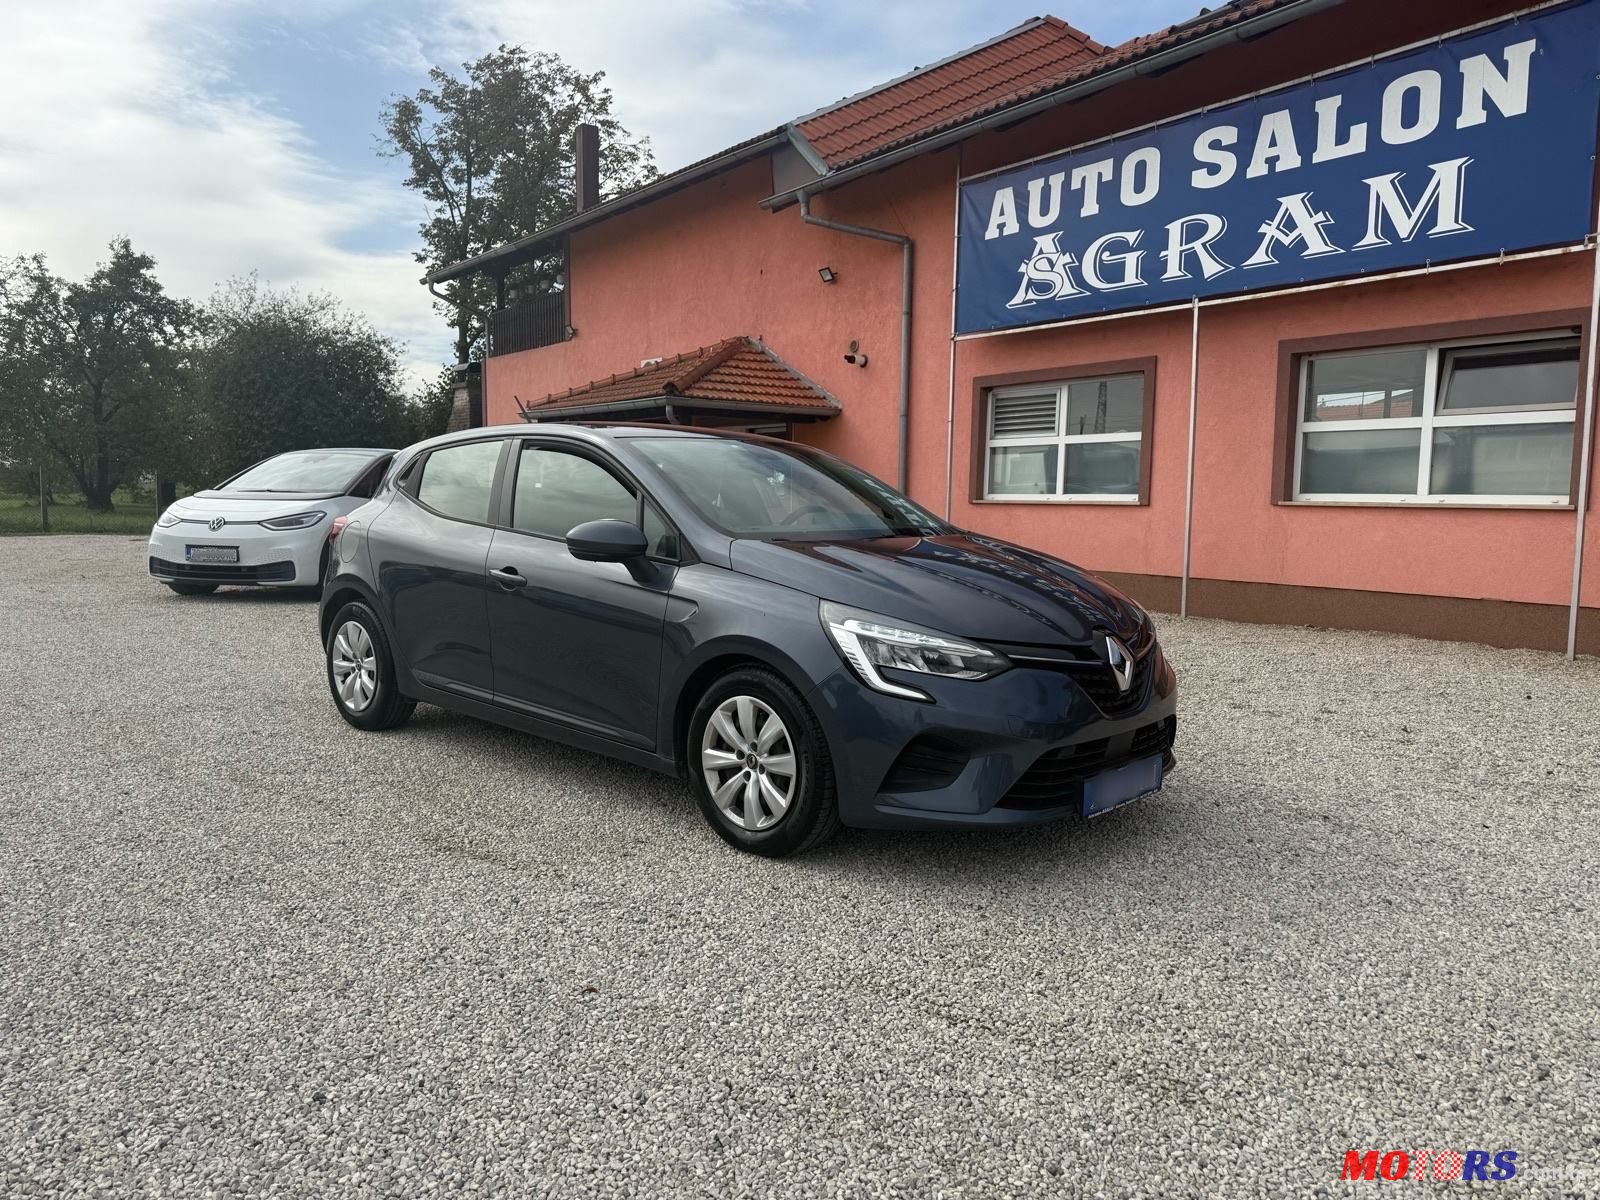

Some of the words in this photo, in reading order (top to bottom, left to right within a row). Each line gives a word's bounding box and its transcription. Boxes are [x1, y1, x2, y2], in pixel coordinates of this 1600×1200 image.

[985, 147, 1161, 241] AUTO
[1191, 38, 1537, 189] SALON
[1006, 157, 1475, 309] AGRAM
